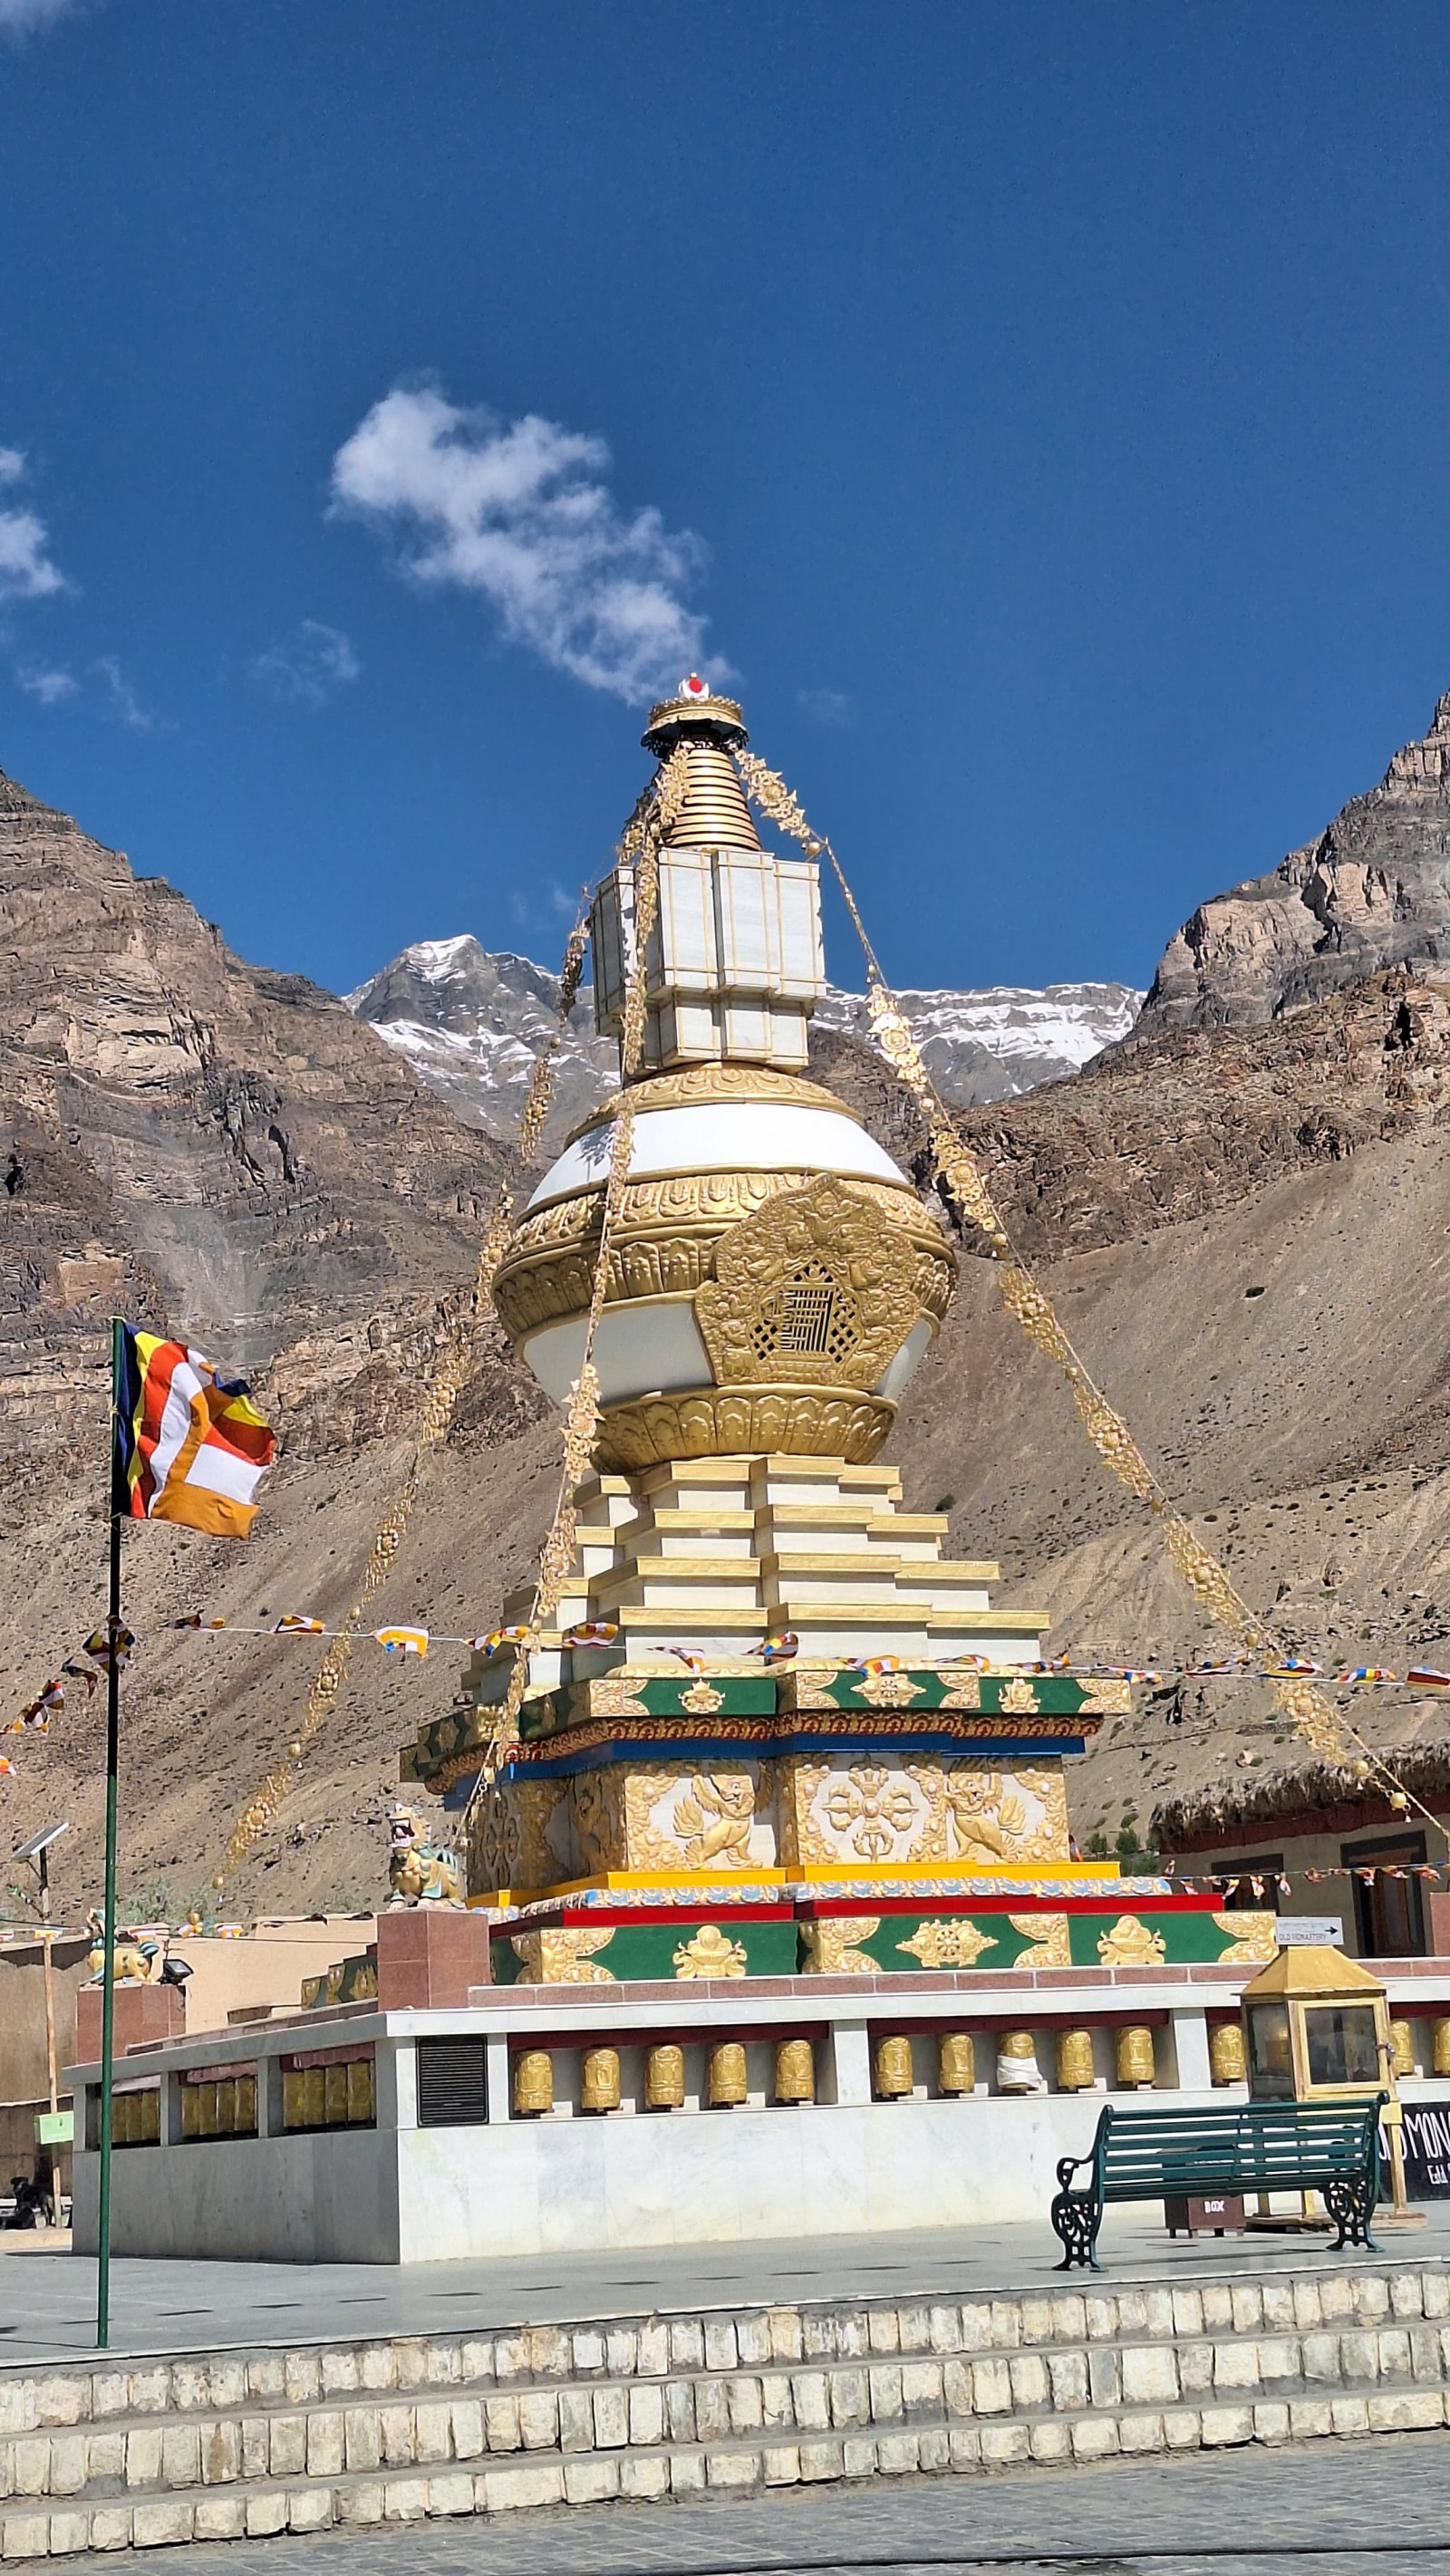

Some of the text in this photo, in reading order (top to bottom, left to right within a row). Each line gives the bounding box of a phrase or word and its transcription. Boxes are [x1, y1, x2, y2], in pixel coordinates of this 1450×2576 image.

[1279, 1933, 1326, 1941] OLD MONASTERY
[1404, 2110, 1450, 2159] MON
[1204, 2200, 1224, 2214] BOX
